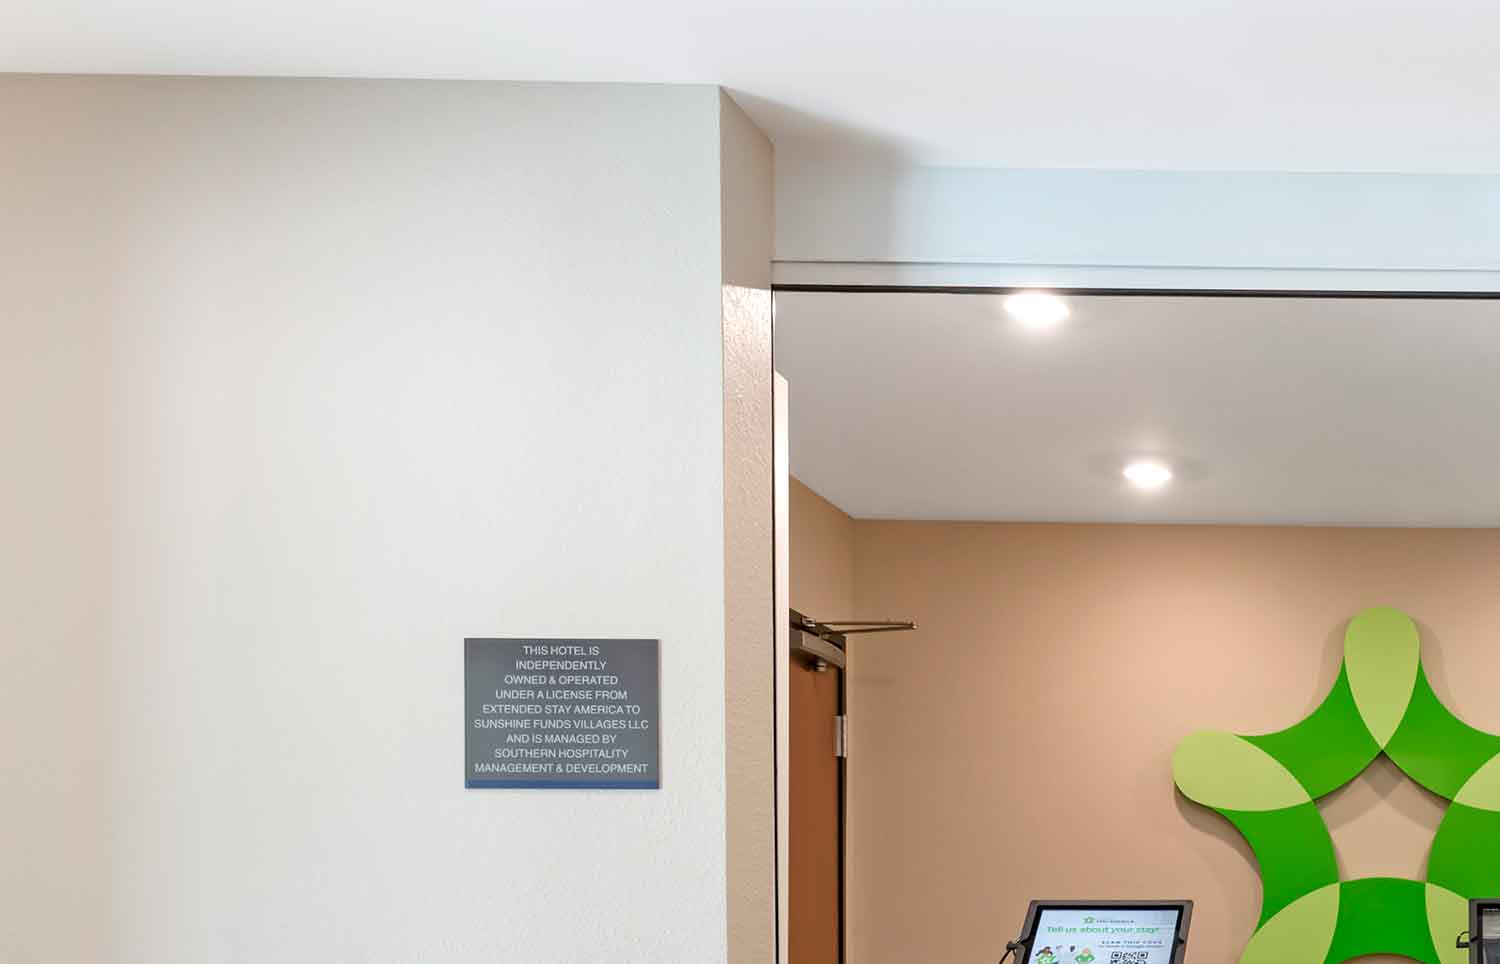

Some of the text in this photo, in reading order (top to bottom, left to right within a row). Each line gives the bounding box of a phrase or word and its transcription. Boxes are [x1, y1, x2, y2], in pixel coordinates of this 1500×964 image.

[523, 646, 600, 656] THIS HOTEL IS
[516, 661, 607, 671] INDEPENDENTLY
[504, 675, 619, 685] OWNED & OPERATED
[496, 690, 628, 700] UNDER A LICENSE FROM
[482, 705, 640, 715] EXTENDED STAY AMERICA TO
[474, 719, 649, 729] SUNSHINE FUNDS VILLAGES LLC
[506, 734, 617, 744] AND IS MANAGED BY
[494, 749, 629, 759] SOUTHERN HOSPITALITY
[474, 763, 648, 773] MANAGEMENT & DEVELOPMENT
